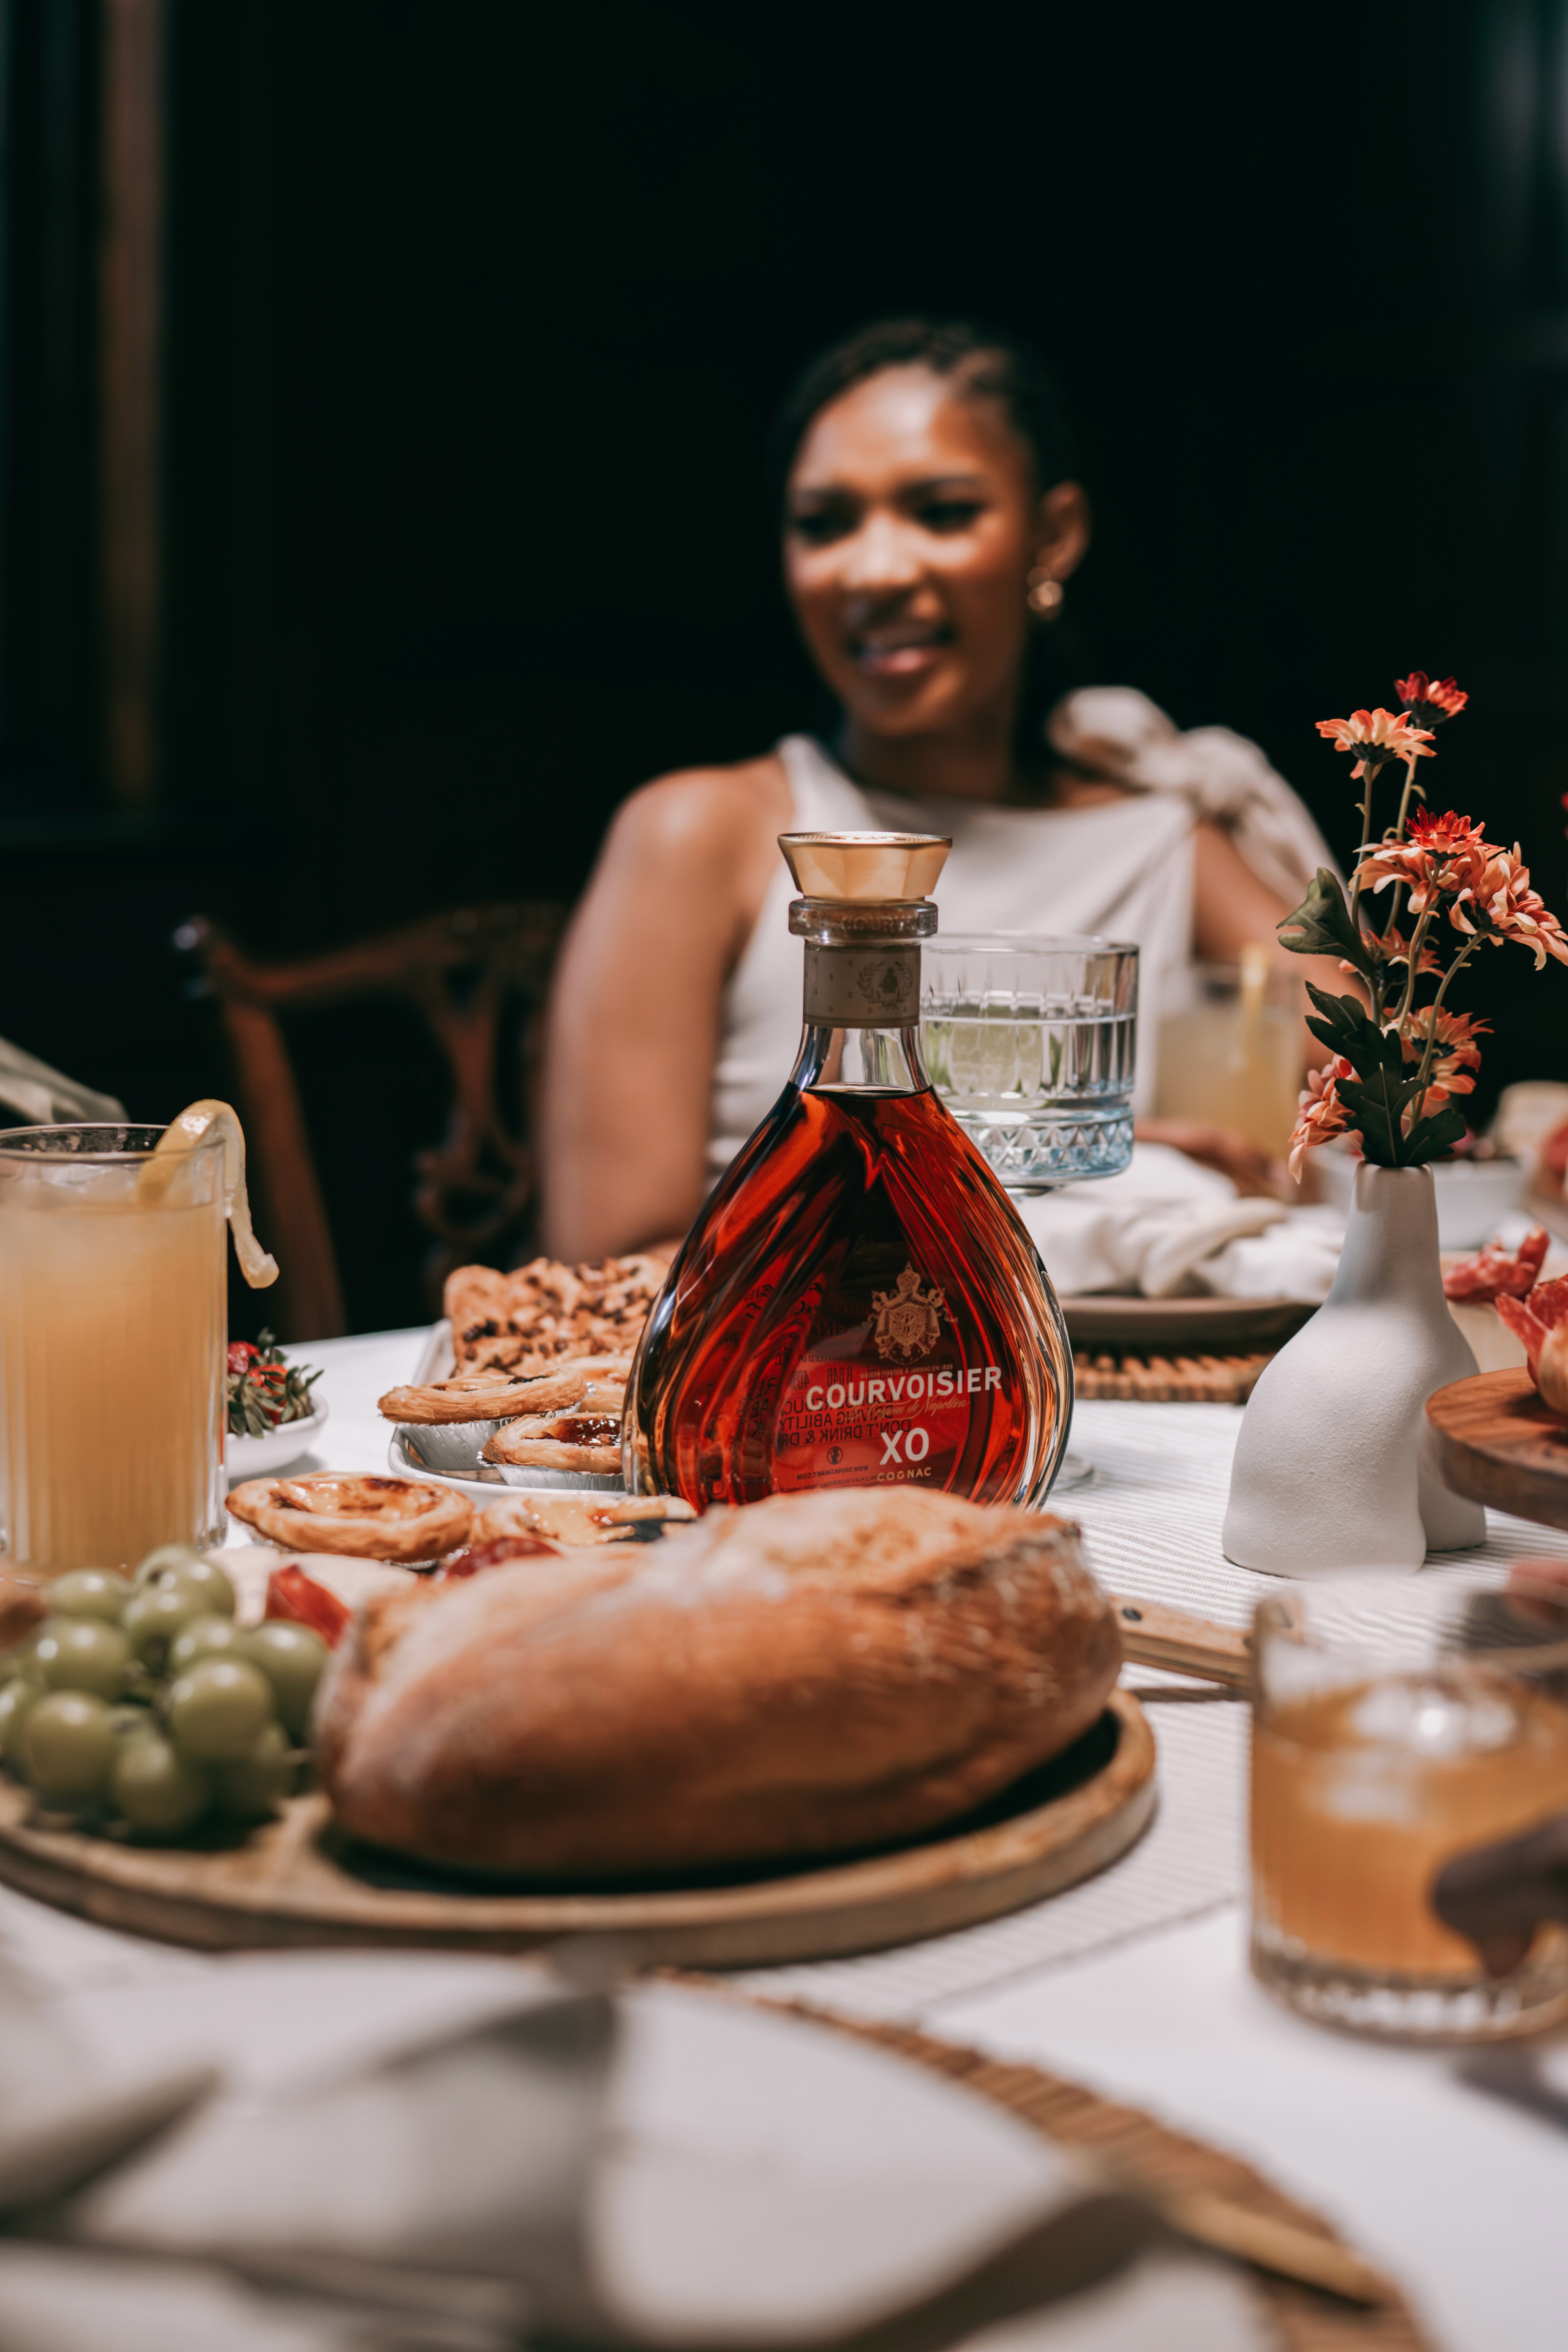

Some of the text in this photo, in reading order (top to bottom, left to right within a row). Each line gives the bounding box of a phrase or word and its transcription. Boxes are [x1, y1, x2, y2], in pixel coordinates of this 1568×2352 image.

[806, 1367, 1002, 1411] COURVOISIER
[879, 1427, 929, 1465] XO
[877, 1467, 931, 1482] COGNAC
